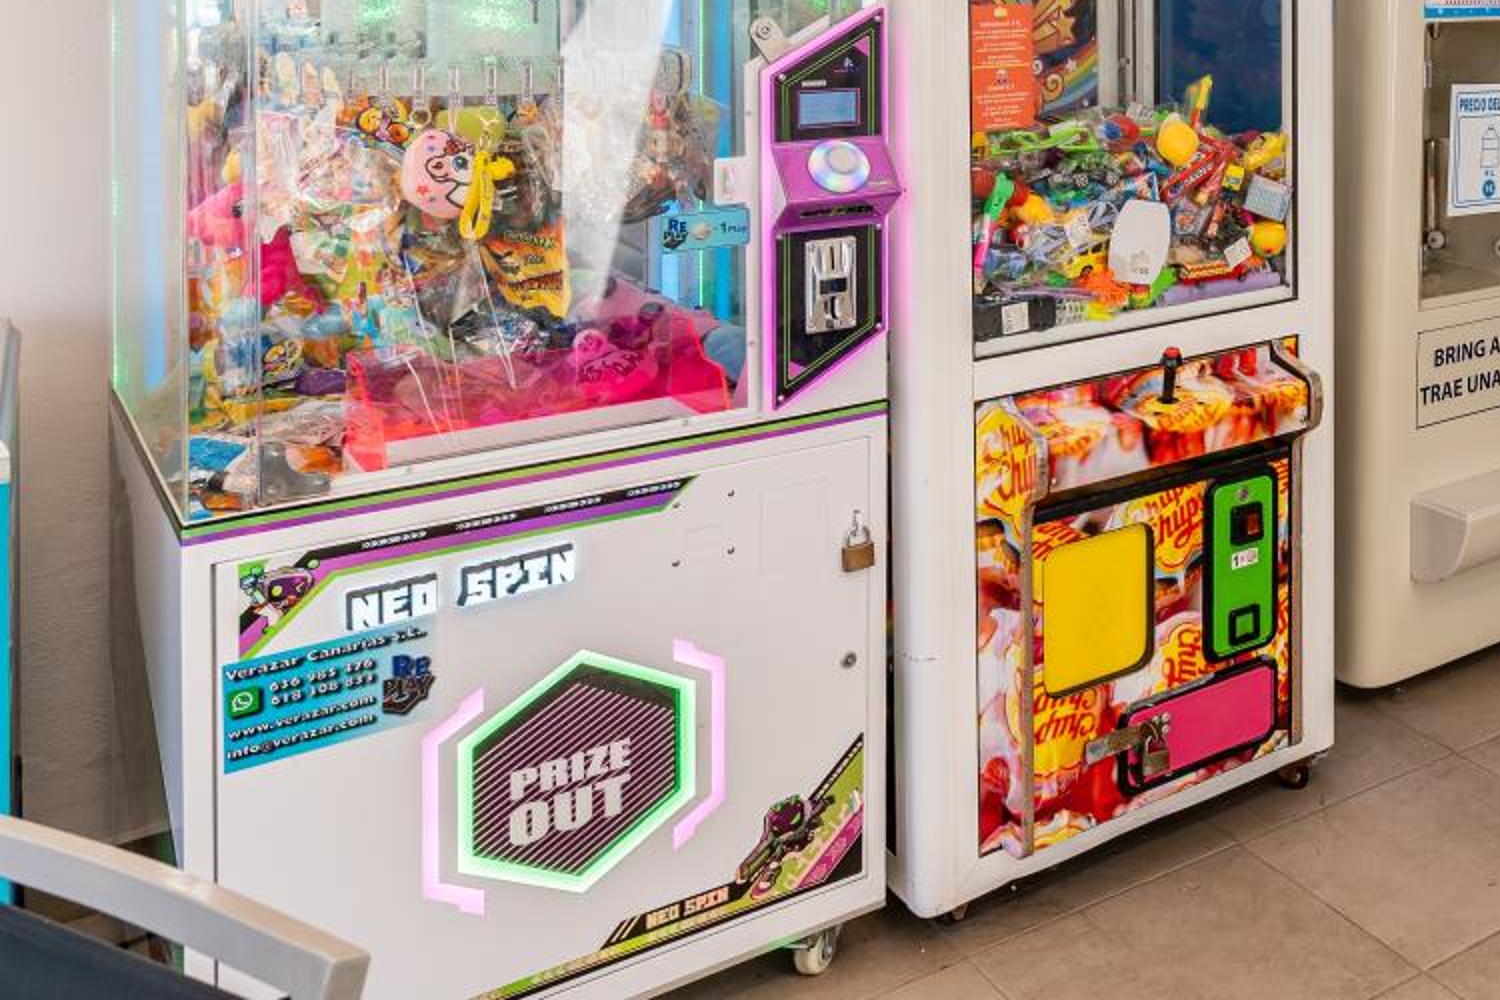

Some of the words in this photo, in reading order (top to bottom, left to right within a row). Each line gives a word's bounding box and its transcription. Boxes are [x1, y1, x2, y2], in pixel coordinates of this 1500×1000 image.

[1433, 335, 1486, 369] BRING
[1490, 336, 1500, 356] A
[1420, 379, 1464, 407] TRAE
[346, 572, 439, 632] NEO
[457, 543, 575, 607] SPIN
[225, 657, 301, 682] Verazar
[307, 636, 391, 662] Canarias
[227, 695, 377, 740] www.verazar.com
[227, 714, 377, 761] info@verazar.com
[509, 735, 633, 800] PRIZE
[509, 774, 631, 847] OUT
